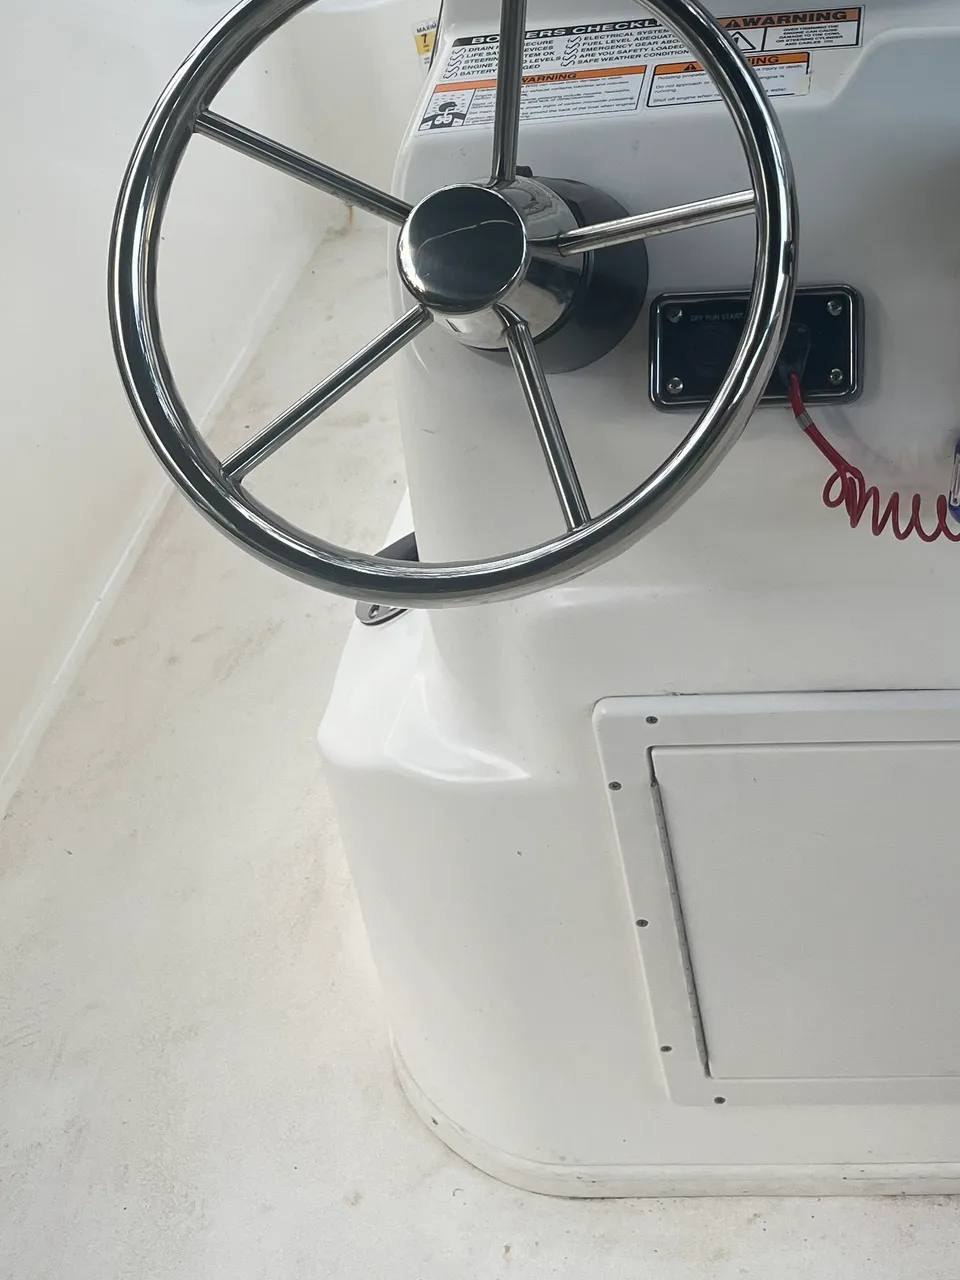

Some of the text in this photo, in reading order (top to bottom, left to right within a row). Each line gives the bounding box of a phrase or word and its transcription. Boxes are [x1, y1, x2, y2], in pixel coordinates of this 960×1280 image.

[743, 11, 847, 26] WARNING
[572, 20, 661, 34] CHECKL
[584, 32, 634, 41] ELECTRICAL
[524, 39, 554, 47] ECURE
[581, 43, 633, 53] EMERGENCY
[651, 44, 684, 52] LOADED
[601, 54, 641, 62] WEATHER
[460, 68, 497, 76] BATTERY
